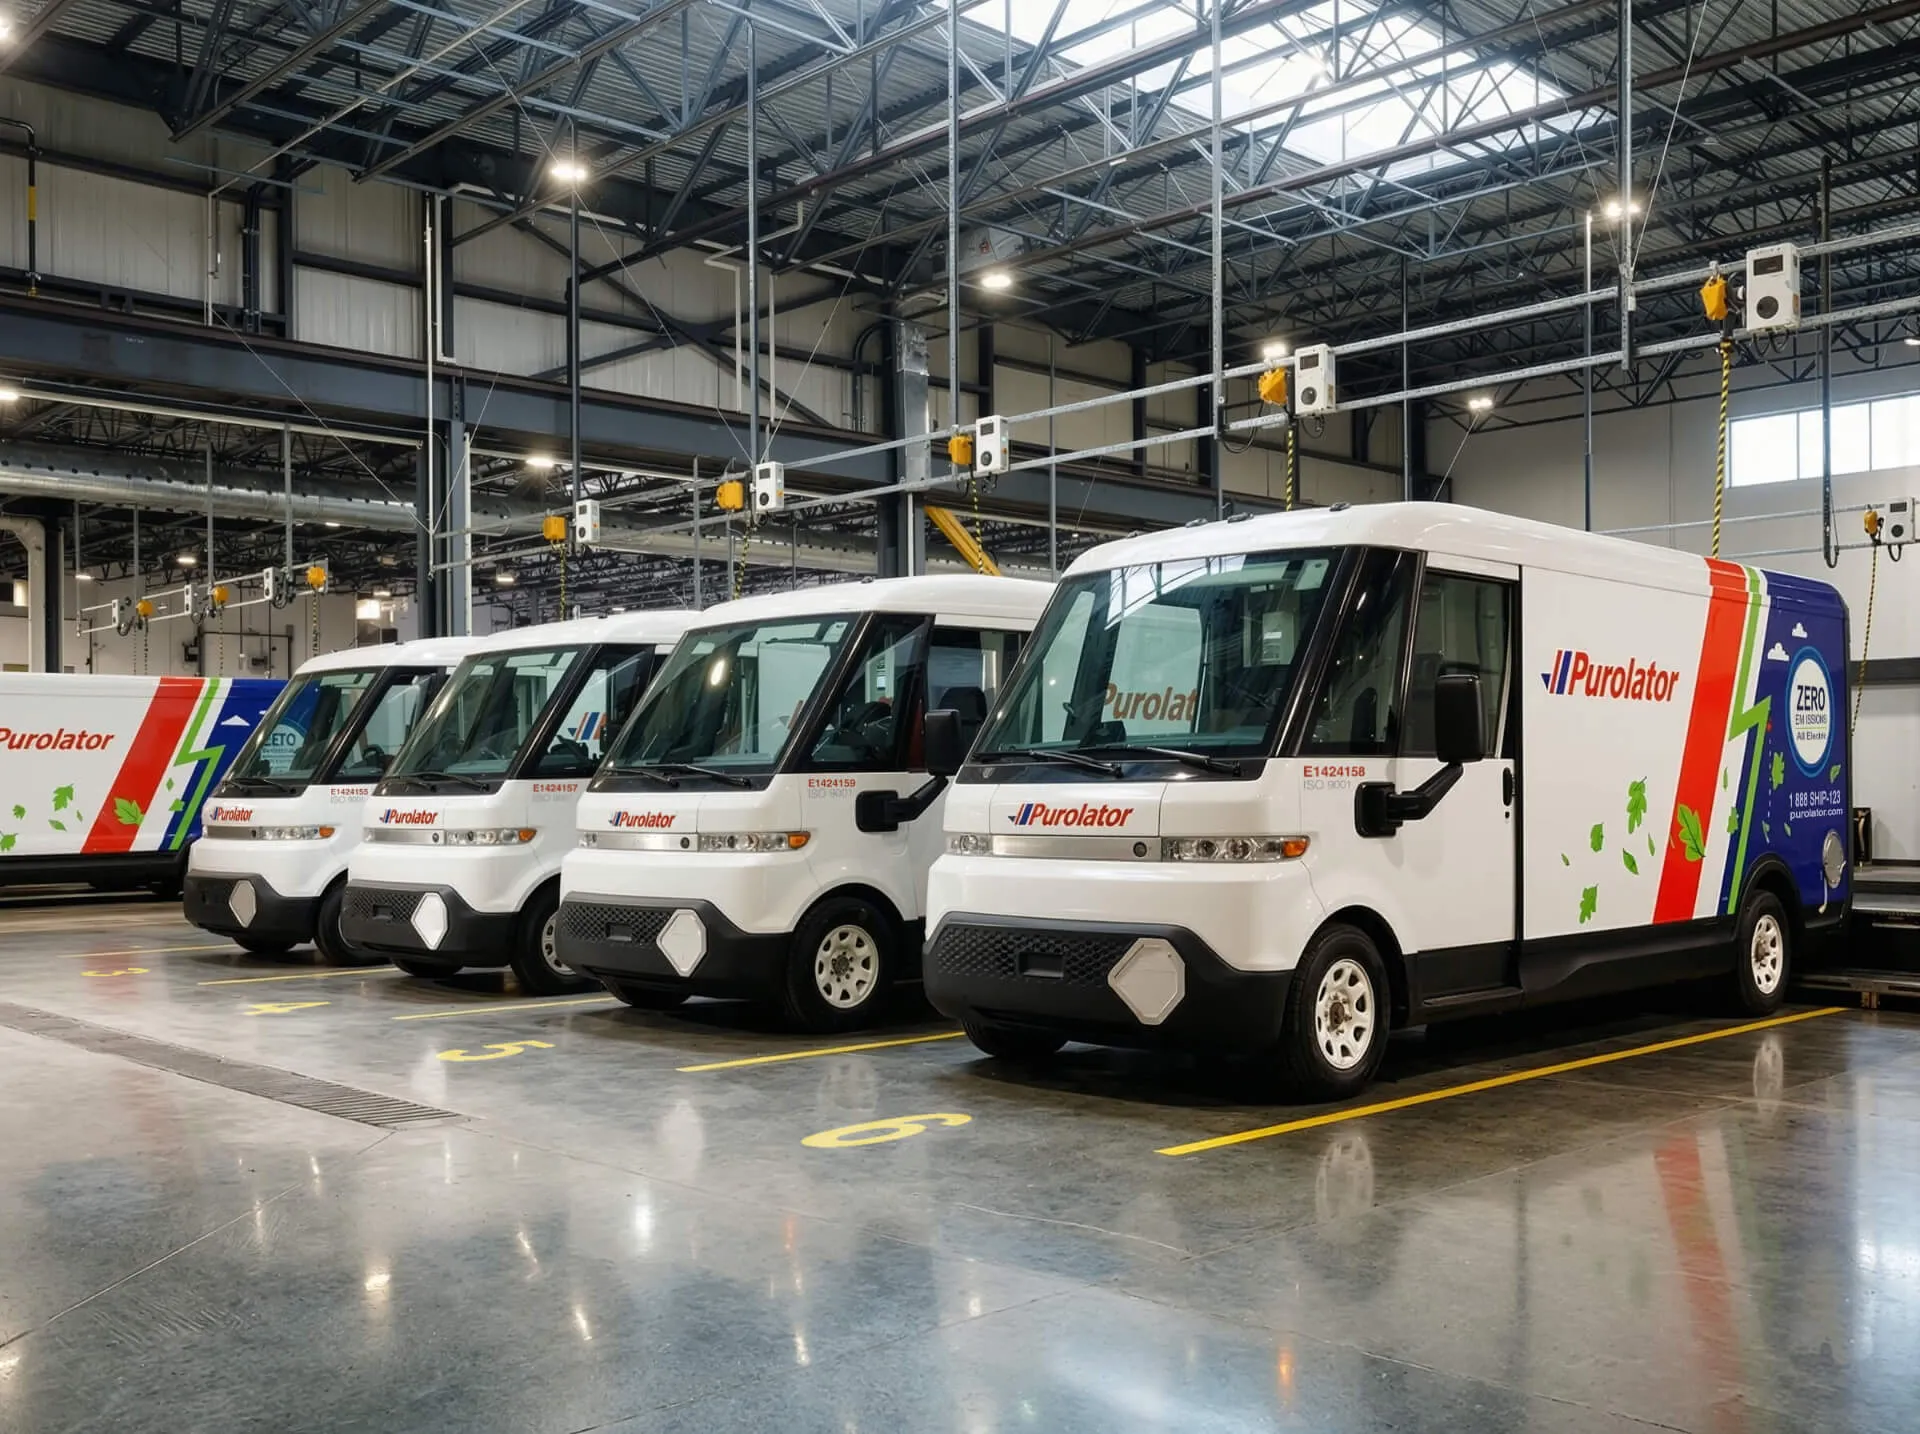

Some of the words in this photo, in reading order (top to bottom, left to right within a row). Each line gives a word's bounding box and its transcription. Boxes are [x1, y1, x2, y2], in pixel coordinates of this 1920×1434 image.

[1567, 650, 1680, 702] Purolator
[1796, 684, 1826, 711] ZERO
[1303, 765, 1366, 778] E1424158
[533, 783, 578, 793] E1424157
[807, 778, 857, 788] E1424159
[1303, 779, 1325, 791] ISO
[1788, 792, 1793, 808] 1
[1795, 792, 1808, 807] 888
[1809, 789, 1841, 806] SHIP-123
[217, 806, 253, 821] Purolator
[389, 809, 438, 824] Purolator
[619, 811, 676, 828] Purolator
[1028, 803, 1135, 826] Purolator
[1789, 807, 1843, 821] purolator.com
[242, 1001, 331, 1016] 4
[435, 1040, 556, 1062] 5
[801, 1112, 973, 1149] 6
